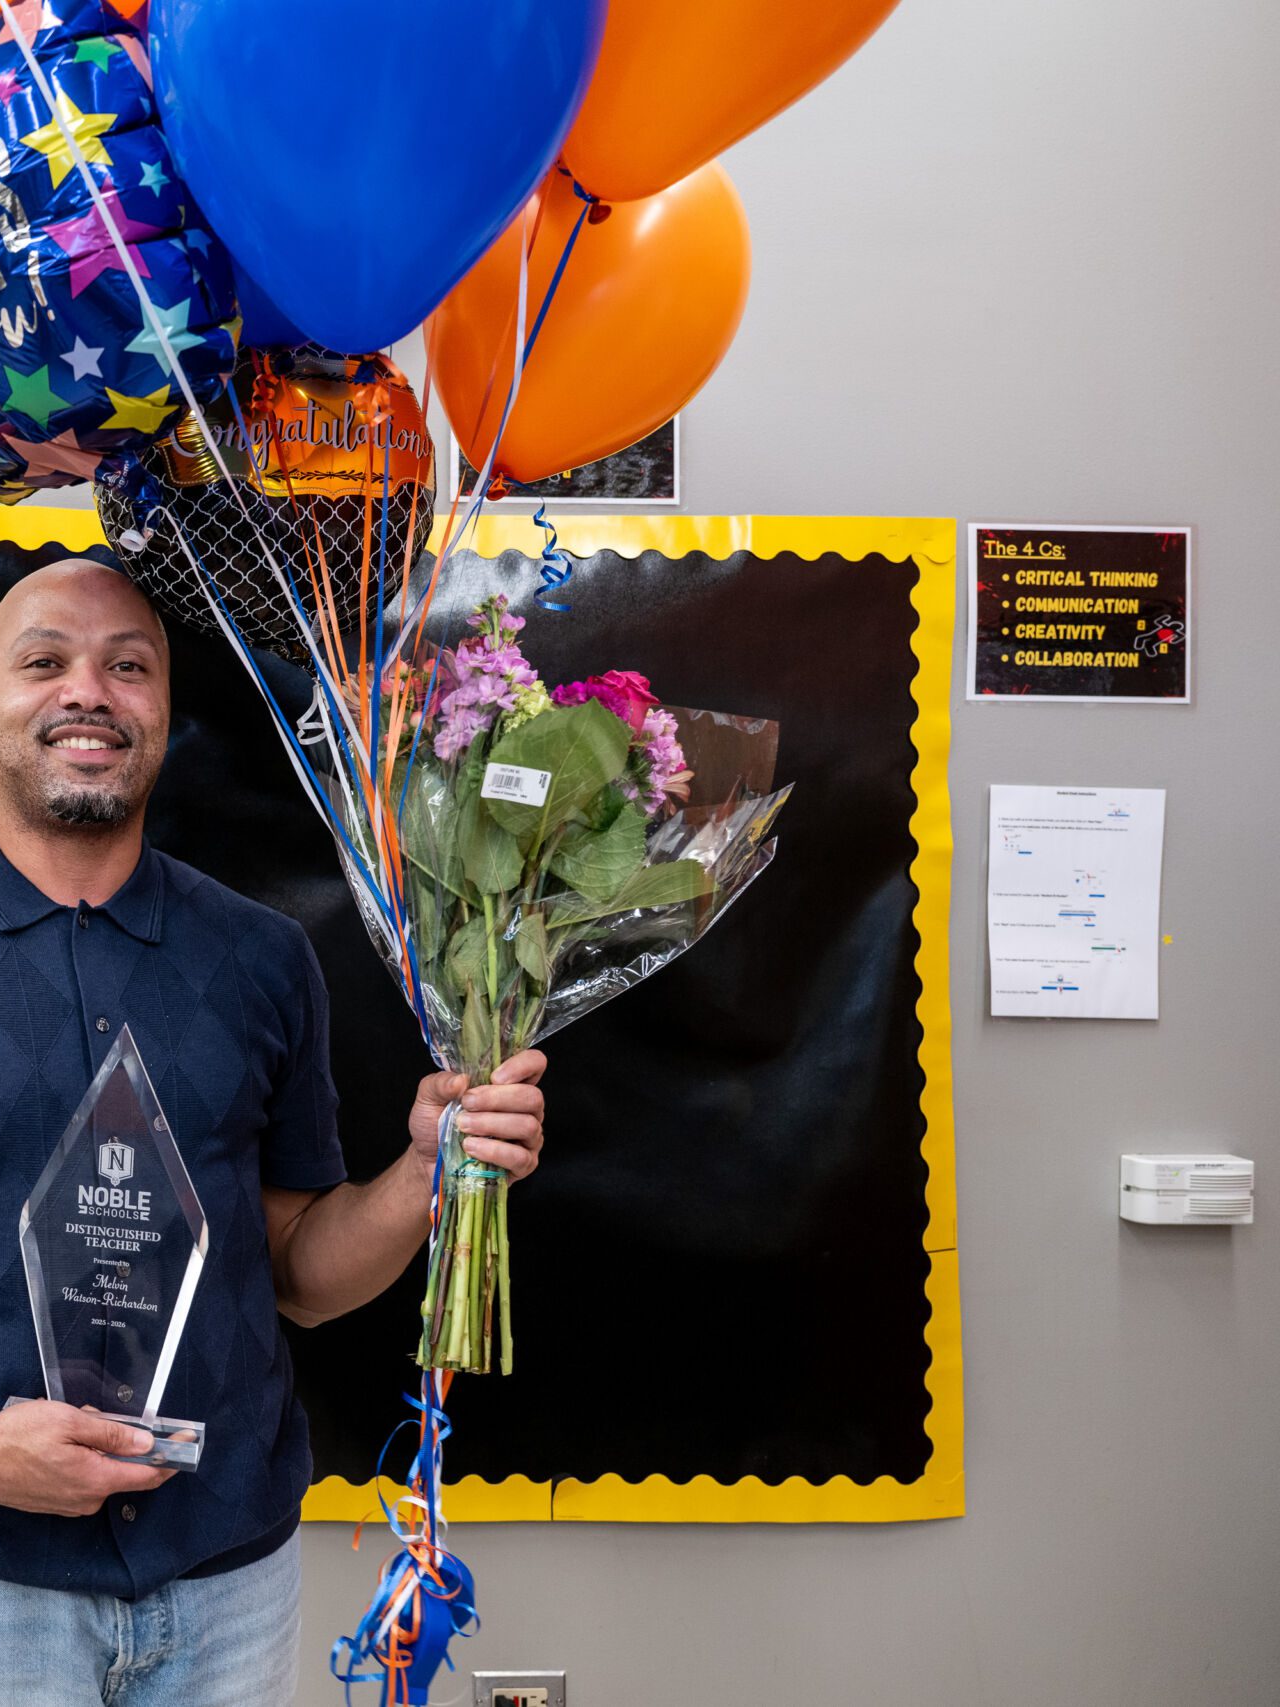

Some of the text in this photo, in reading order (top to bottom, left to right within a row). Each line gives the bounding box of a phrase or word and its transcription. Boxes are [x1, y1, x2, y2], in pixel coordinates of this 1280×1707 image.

[983, 540, 1066, 557] The 4 Cs:
[1015, 570, 1159, 588] CRITICAL THINKING
[1015, 597, 1140, 614] COMMUNICATION
[1015, 624, 1106, 640] CREATIVITY
[1015, 651, 1140, 668] COLLABORATION
[107, 1147, 125, 1171] N
[77, 1184, 152, 1212] NOBLE
[88, 1207, 140, 1220] SCHOOLS
[65, 1222, 162, 1243] DISTINGUISHED
[84, 1236, 141, 1252] TEACHER
[93, 1257, 122, 1266] Presented
[92, 1273, 129, 1292] Melvin
[61, 1286, 158, 1312] Watson-Richardson
[91, 1317, 106, 1327] 2025
[110, 1319, 126, 1328] 2026
